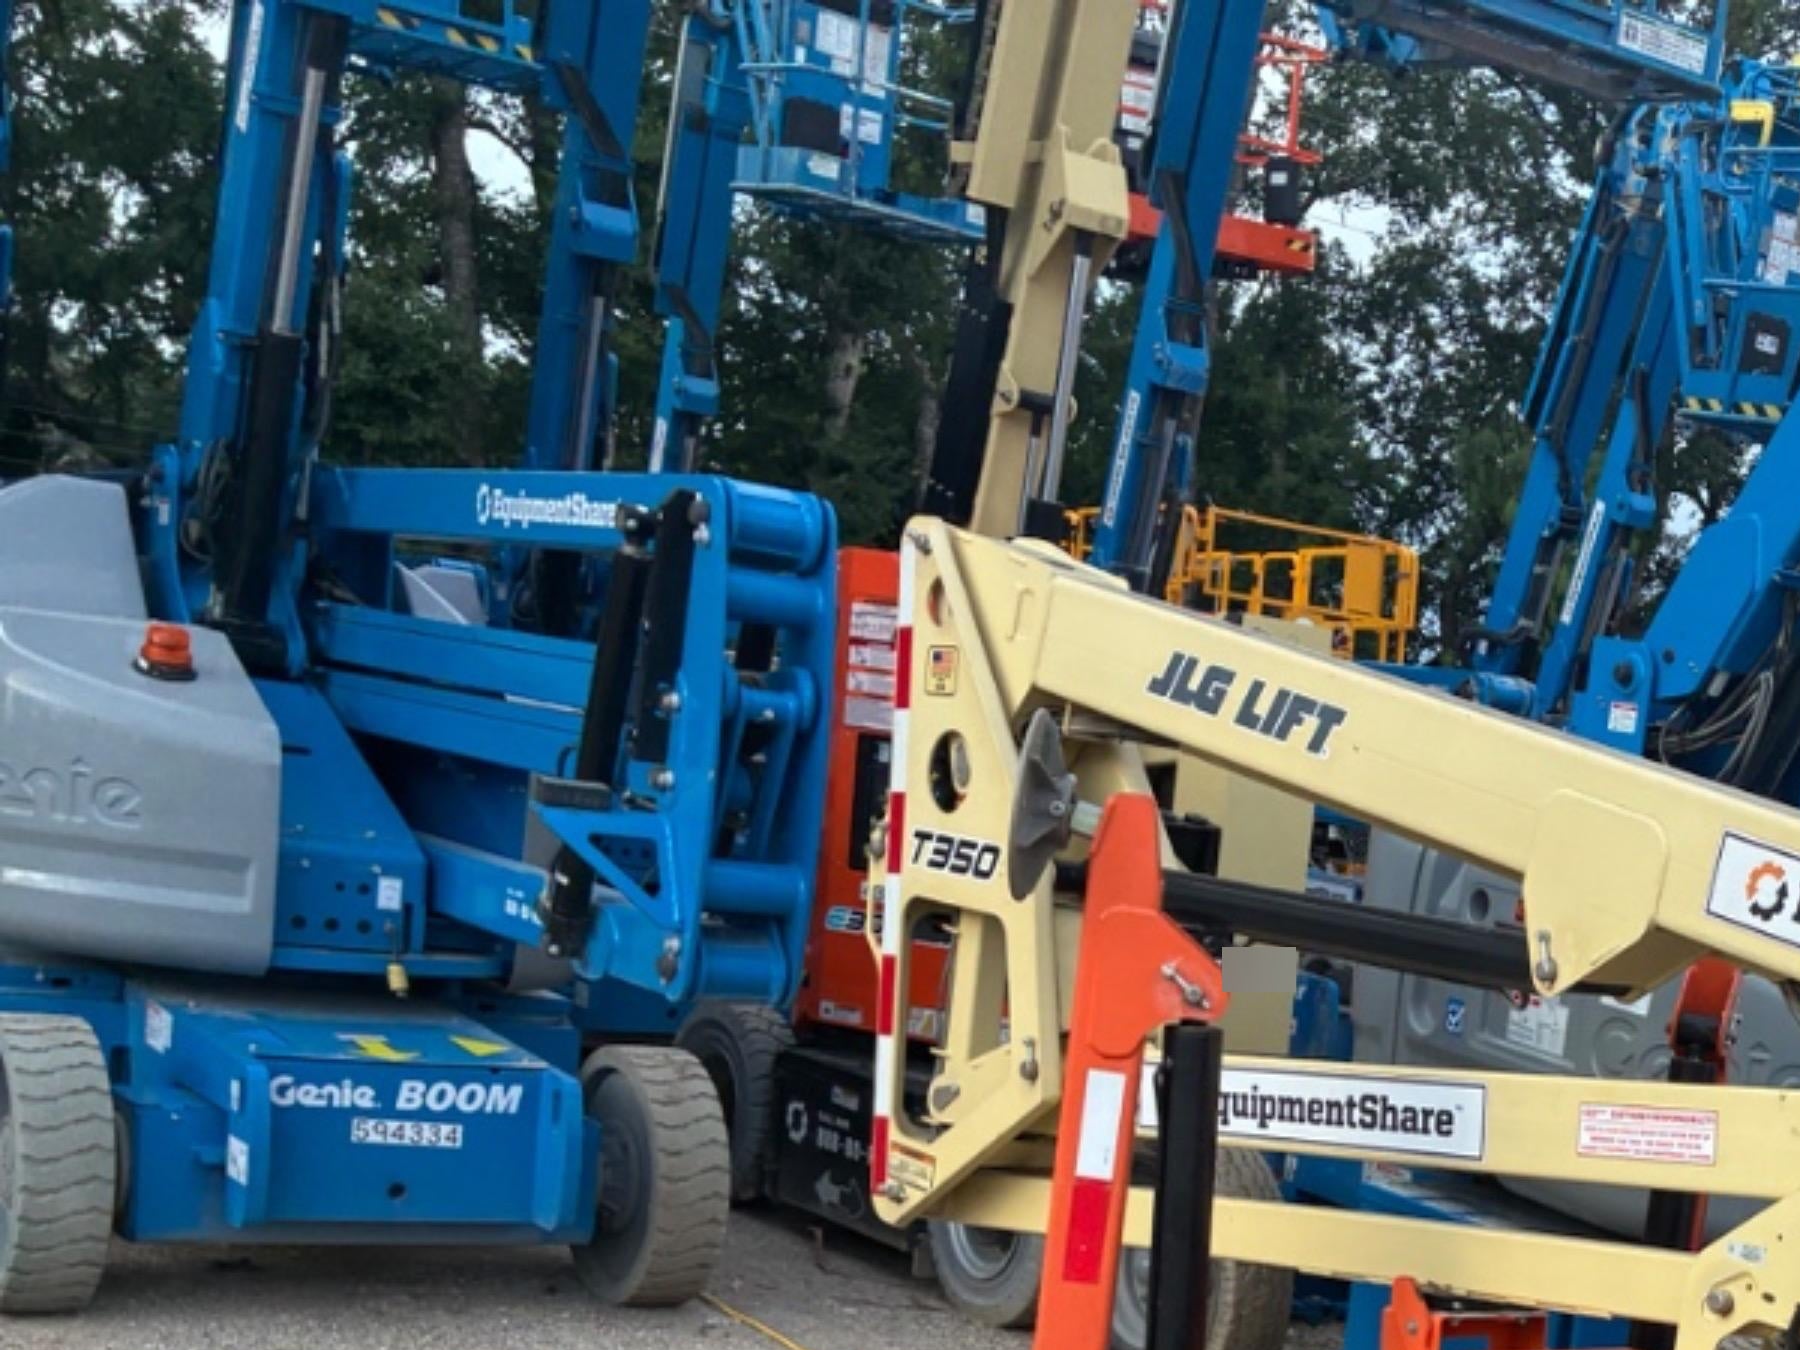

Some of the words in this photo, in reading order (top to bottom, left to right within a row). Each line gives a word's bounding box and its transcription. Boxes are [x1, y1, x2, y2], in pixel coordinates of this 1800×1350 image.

[1146, 650, 1238, 717] JLG
[1233, 678, 1348, 756] LIFT
[911, 829, 1001, 880] T350
[269, 1075, 378, 1109] Genie
[395, 1079, 524, 1114] BOOM
[1217, 1083, 1454, 1138] quipmentShare
